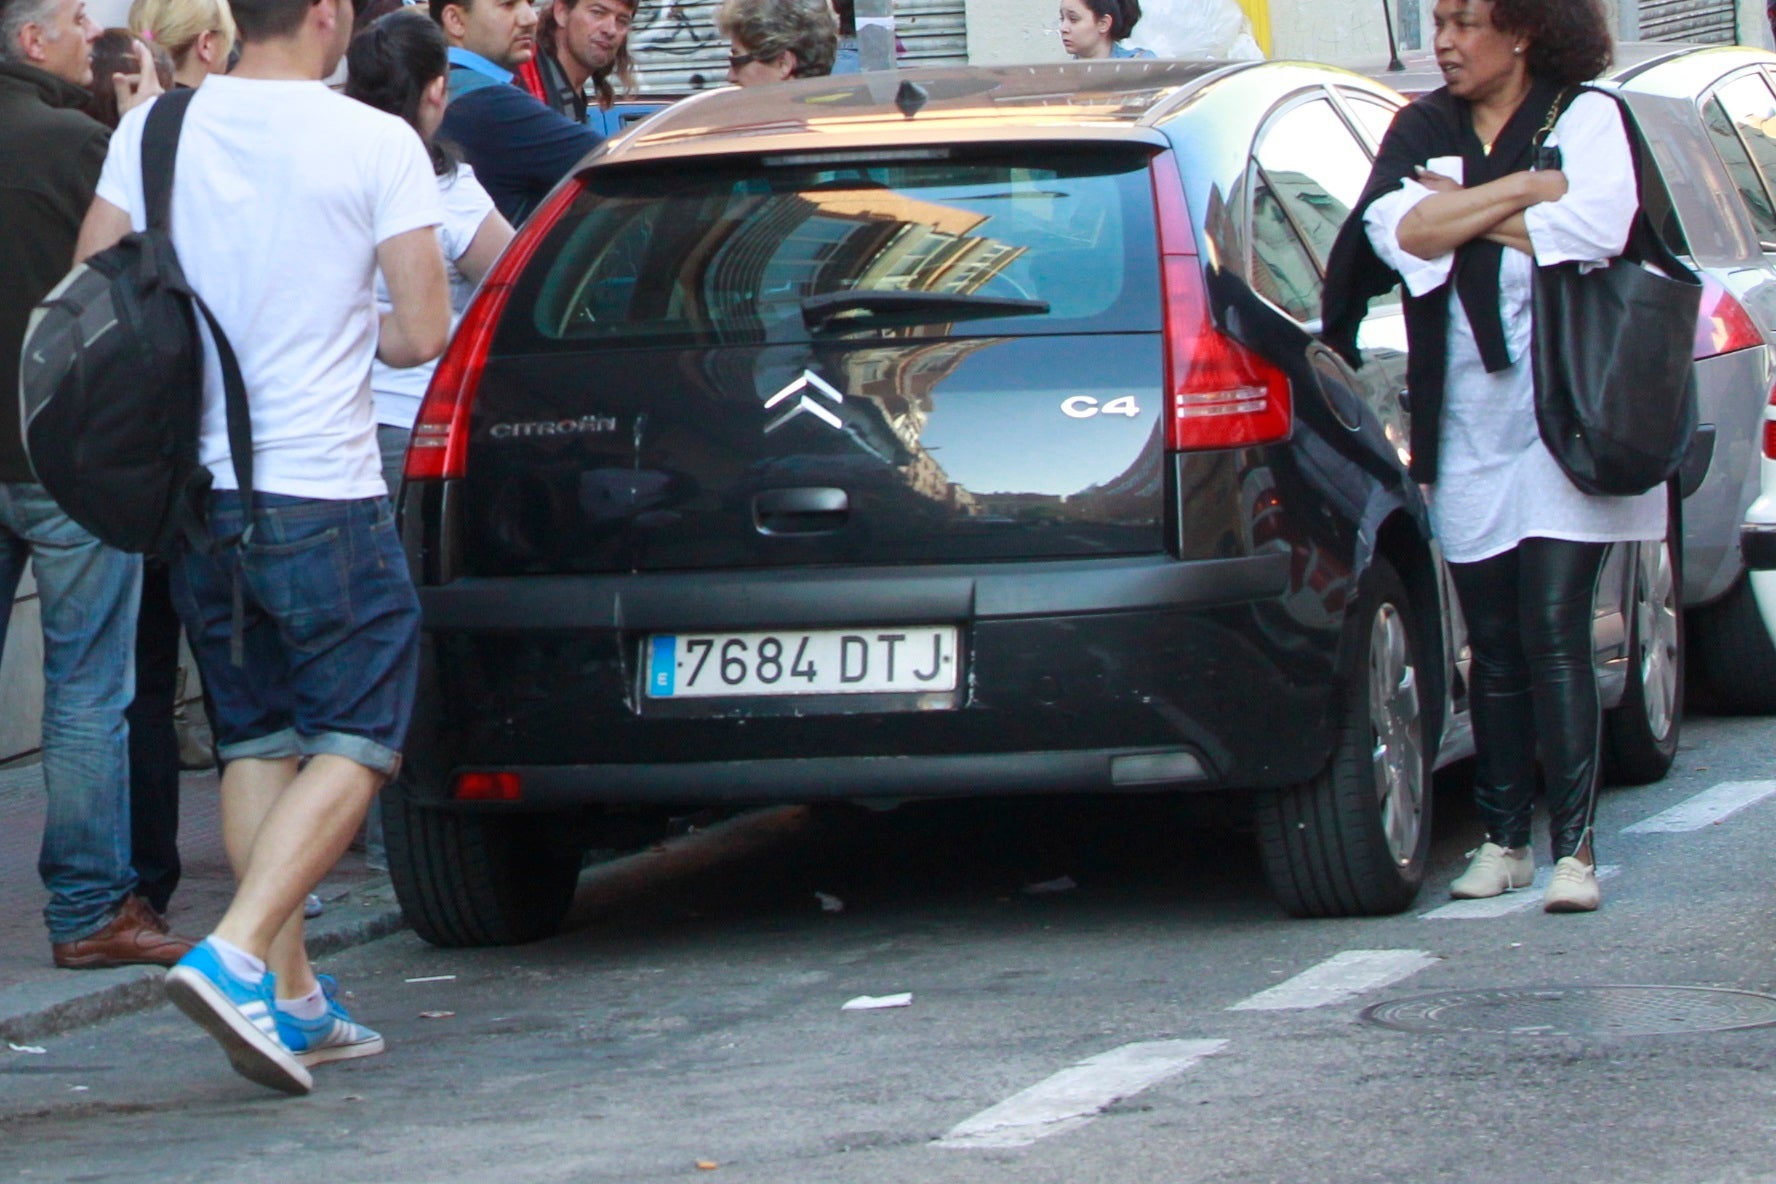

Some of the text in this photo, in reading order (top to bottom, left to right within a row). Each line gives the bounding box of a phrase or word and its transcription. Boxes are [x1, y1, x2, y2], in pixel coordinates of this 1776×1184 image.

[1060, 395, 1141, 418] C4
[489, 414, 616, 438] CITROËN
[686, 633, 942, 687] 7684 DTJ
